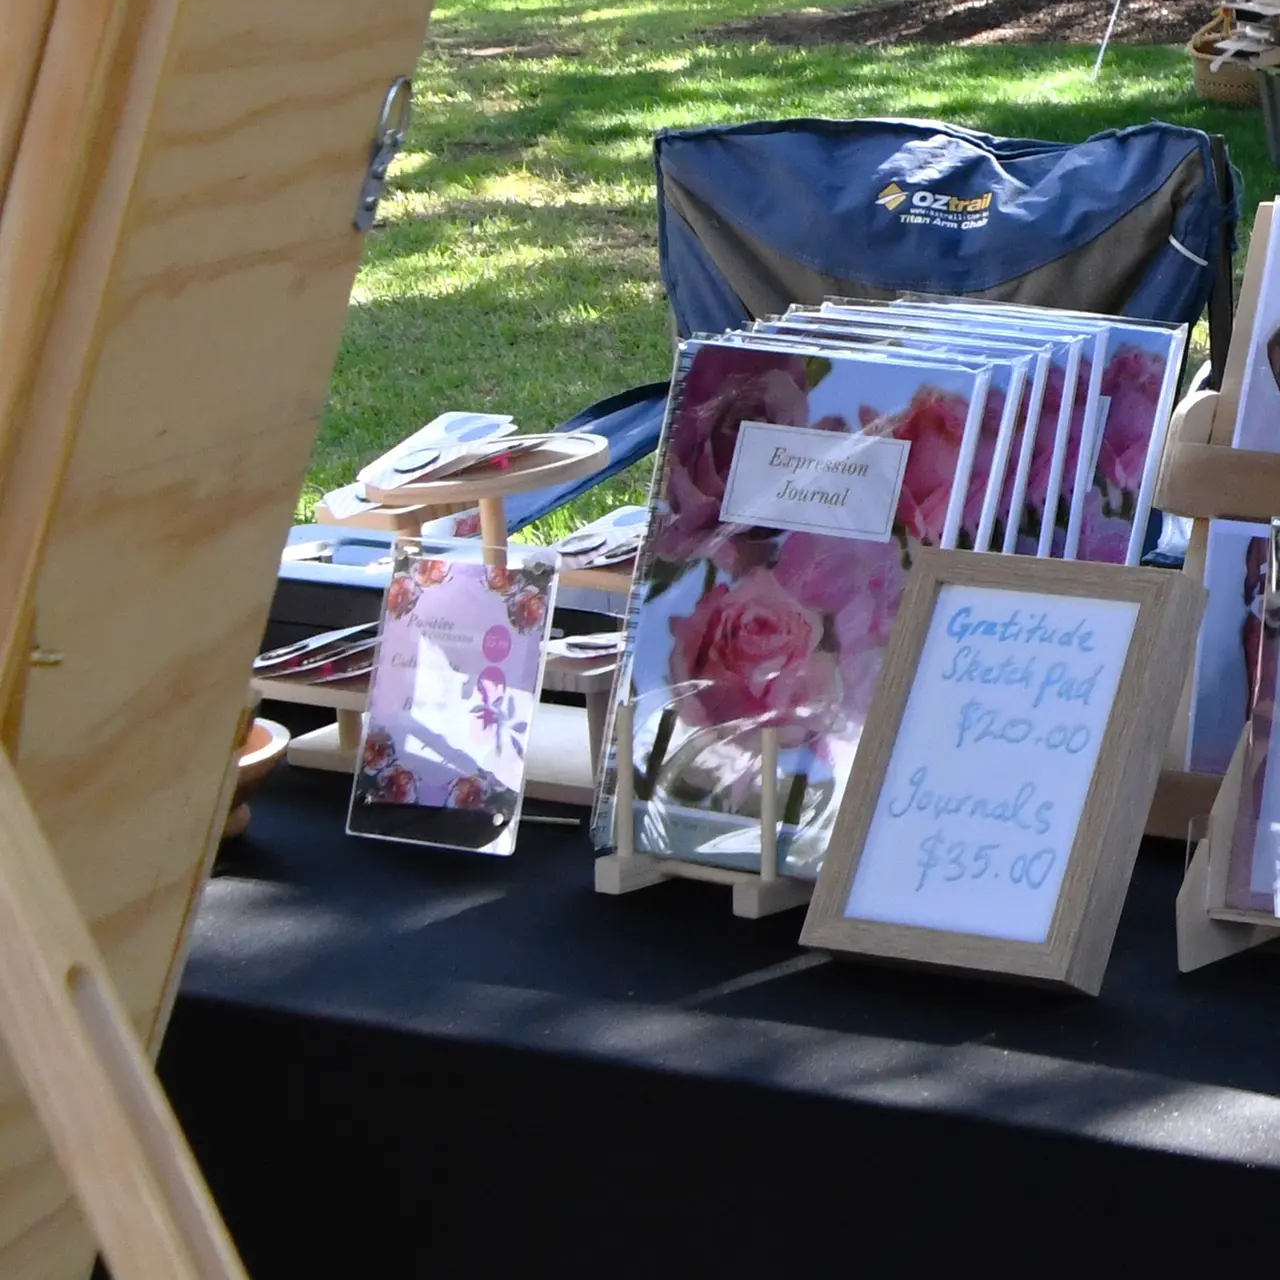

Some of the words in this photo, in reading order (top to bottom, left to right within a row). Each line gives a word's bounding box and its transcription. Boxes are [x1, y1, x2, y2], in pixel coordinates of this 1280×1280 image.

[899, 213, 931, 225] Titan
[932, 217, 959, 229] Arm
[911, 190, 993, 212] OZtrail
[767, 444, 870, 480] Expression
[775, 478, 849, 508] Journal
[946, 606, 1096, 653] Gratitude
[942, 645, 1036, 690] Sketch
[955, 697, 1091, 754] $20.00
[888, 766, 1055, 835] Journals
[915, 829, 1056, 892] $35.00
